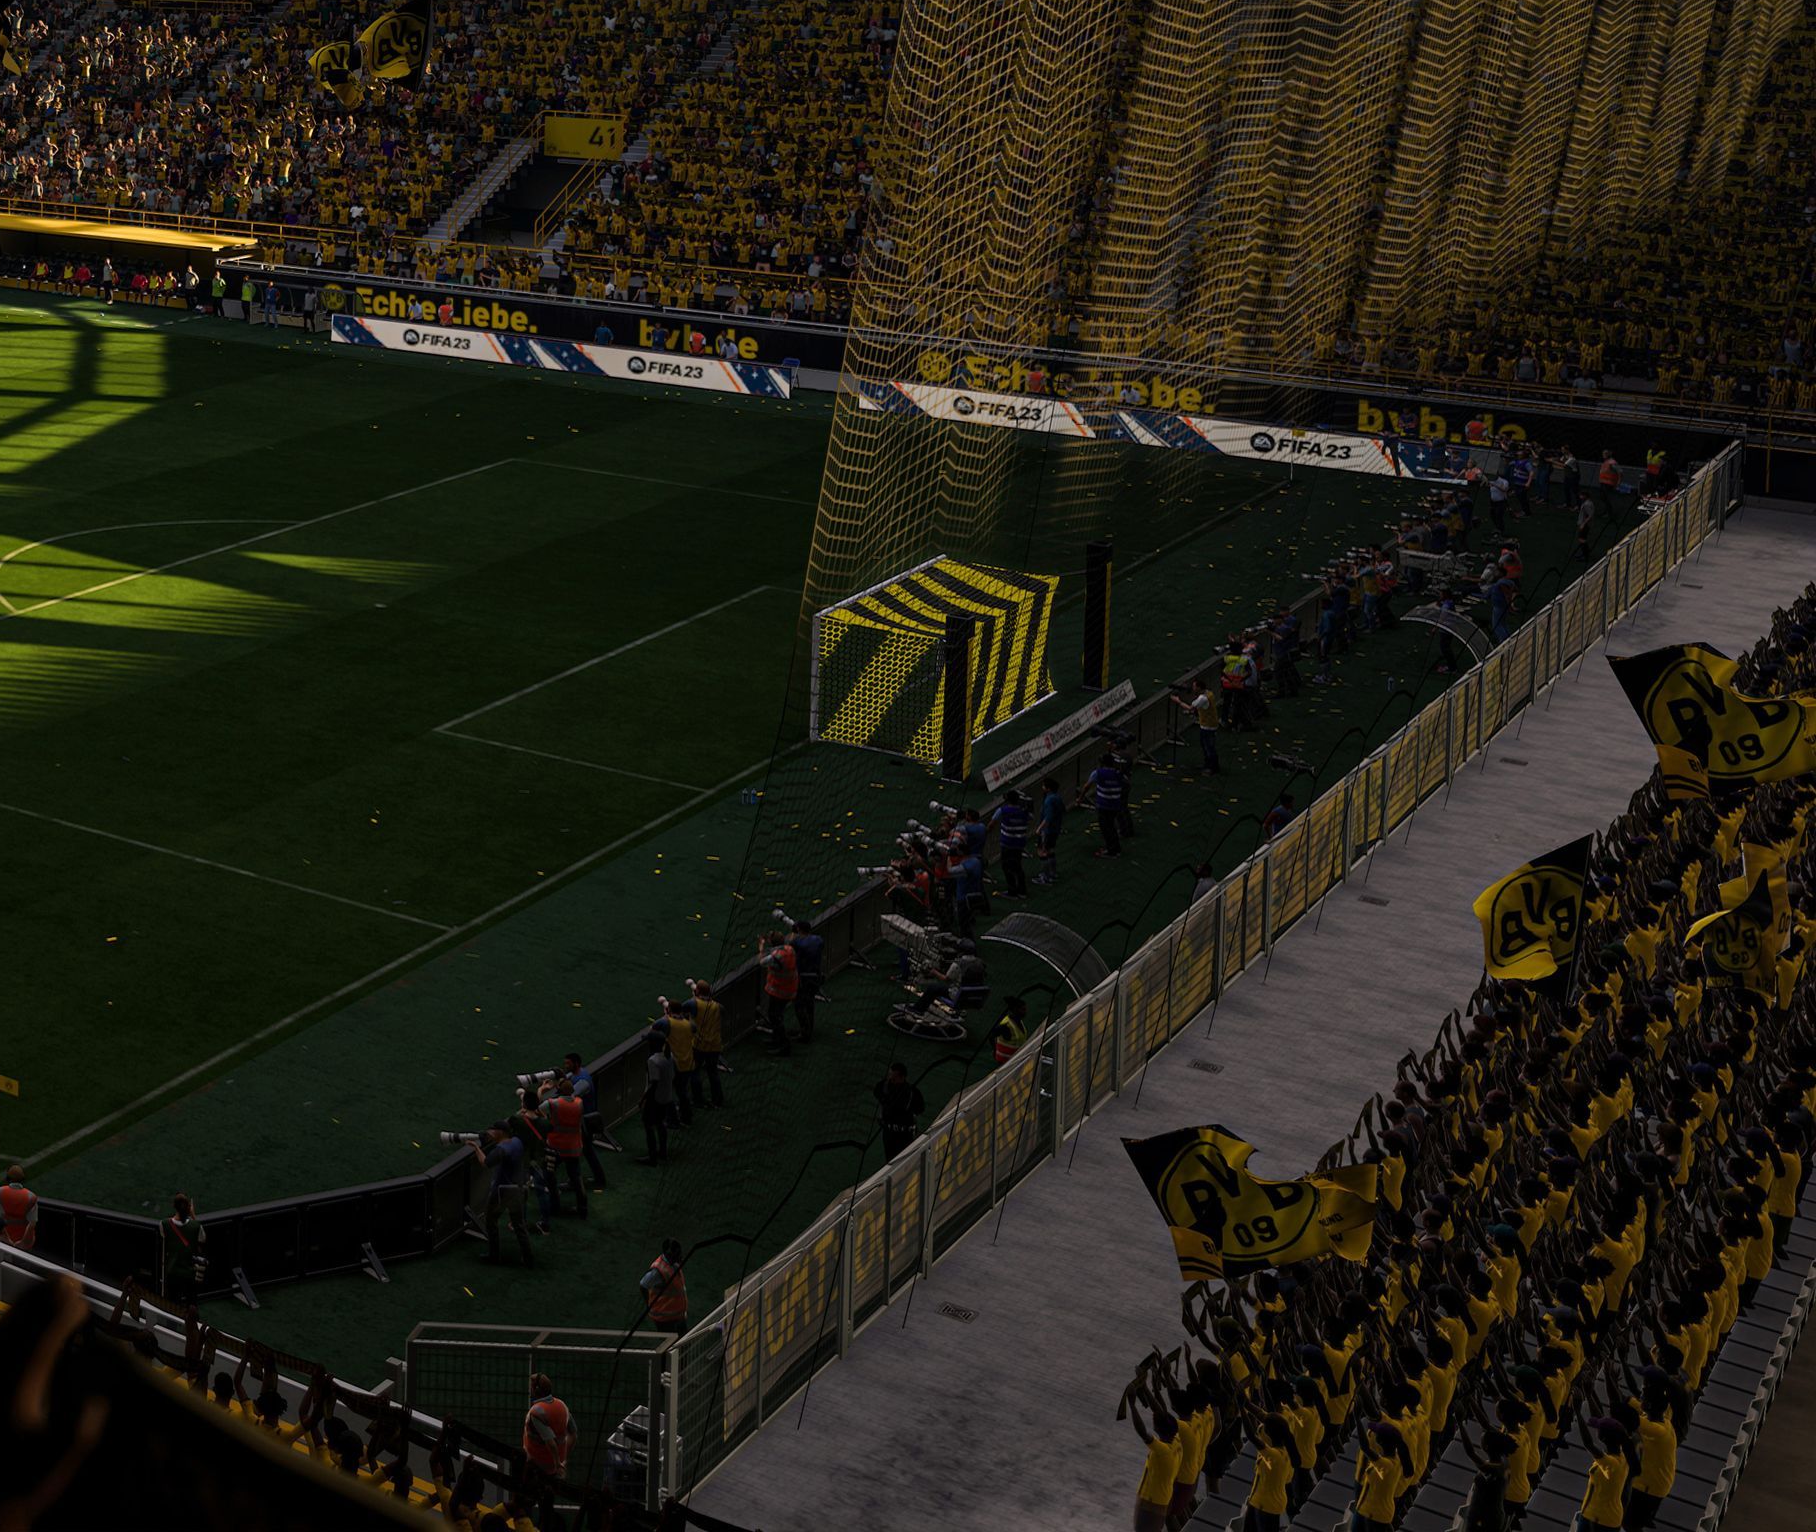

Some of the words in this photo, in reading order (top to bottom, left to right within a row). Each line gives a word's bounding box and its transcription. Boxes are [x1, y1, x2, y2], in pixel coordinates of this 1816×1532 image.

[589, 127, 615, 147] 41
[421, 333, 453, 347] FIFA
[453, 336, 471, 350] 23
[649, 362, 682, 376] FIFA
[684, 366, 703, 378] 23
[978, 402, 1016, 419] FIFA
[1019, 407, 1042, 421] 23
[1277, 439, 1322, 456] FIFA
[1325, 444, 1351, 459] 23
[1718, 734, 1764, 765] 09
[1233, 1215, 1279, 1248] 09
